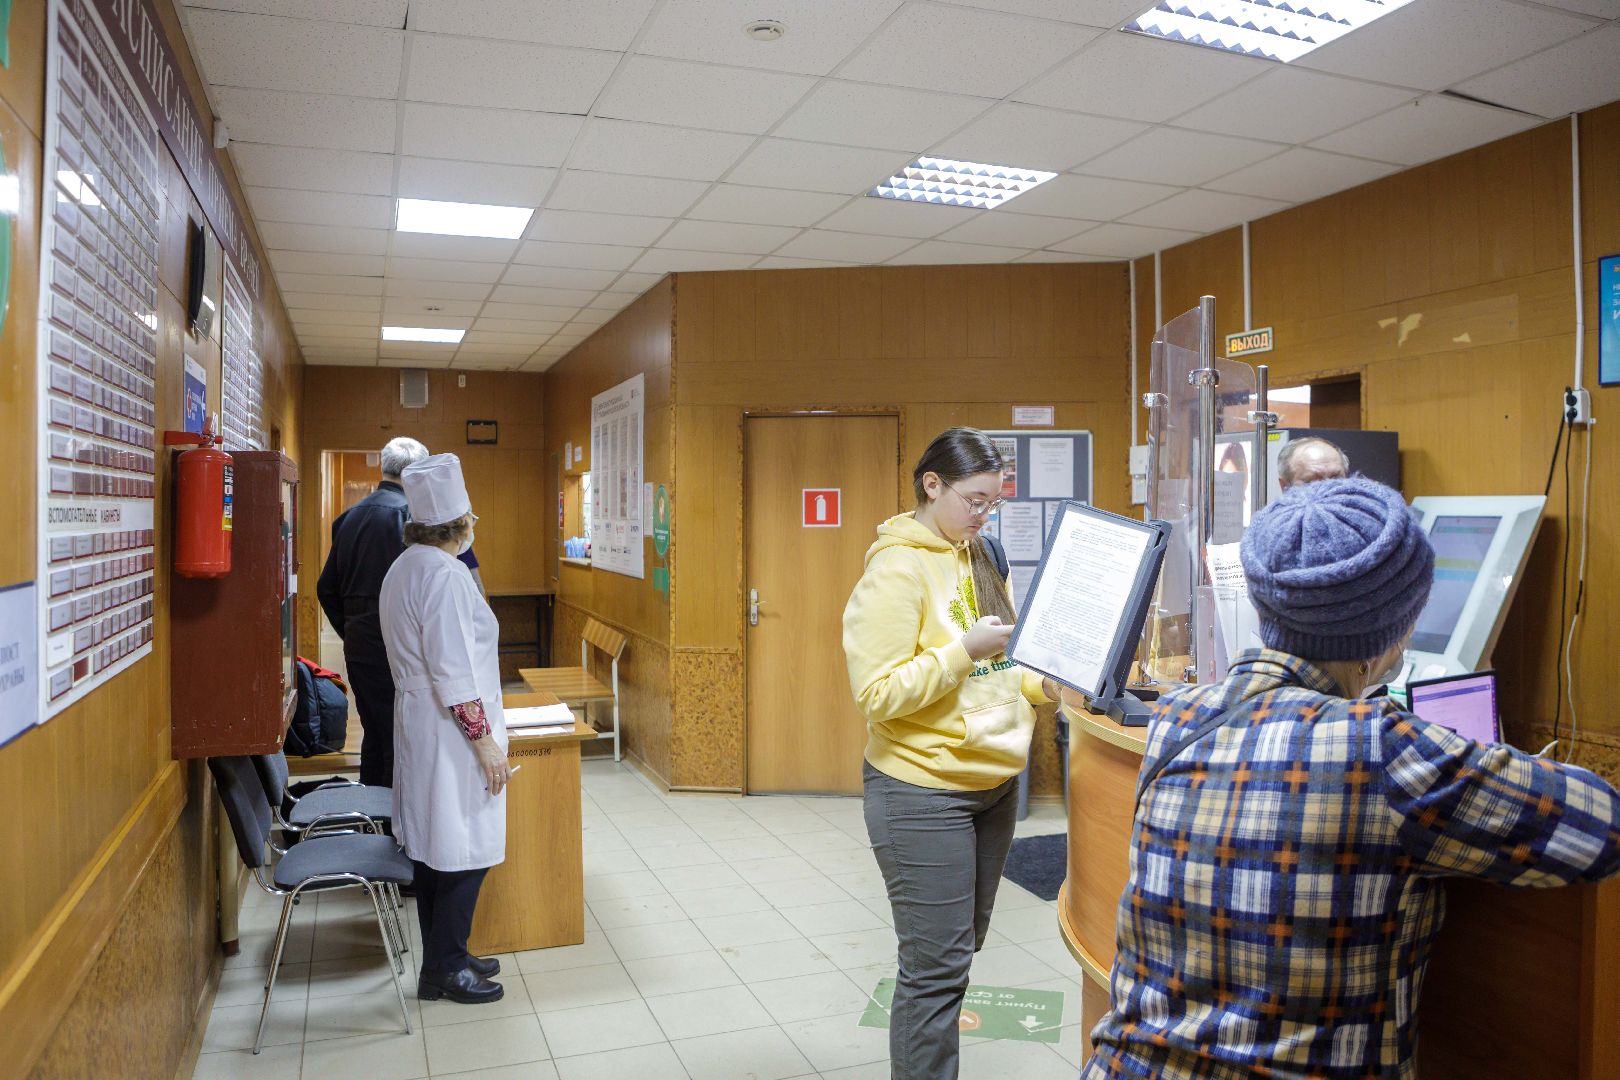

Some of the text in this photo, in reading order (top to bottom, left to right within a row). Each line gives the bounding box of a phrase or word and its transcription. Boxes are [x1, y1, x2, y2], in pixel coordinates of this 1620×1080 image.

[1231, 332, 1269, 352] ВЫХОД
[48, 507, 97, 523] ВСПОМОГАТЕЛЬНЫЕ
[969, 664, 989, 677] ake
[995, 1001, 1046, 1010] Пункт
